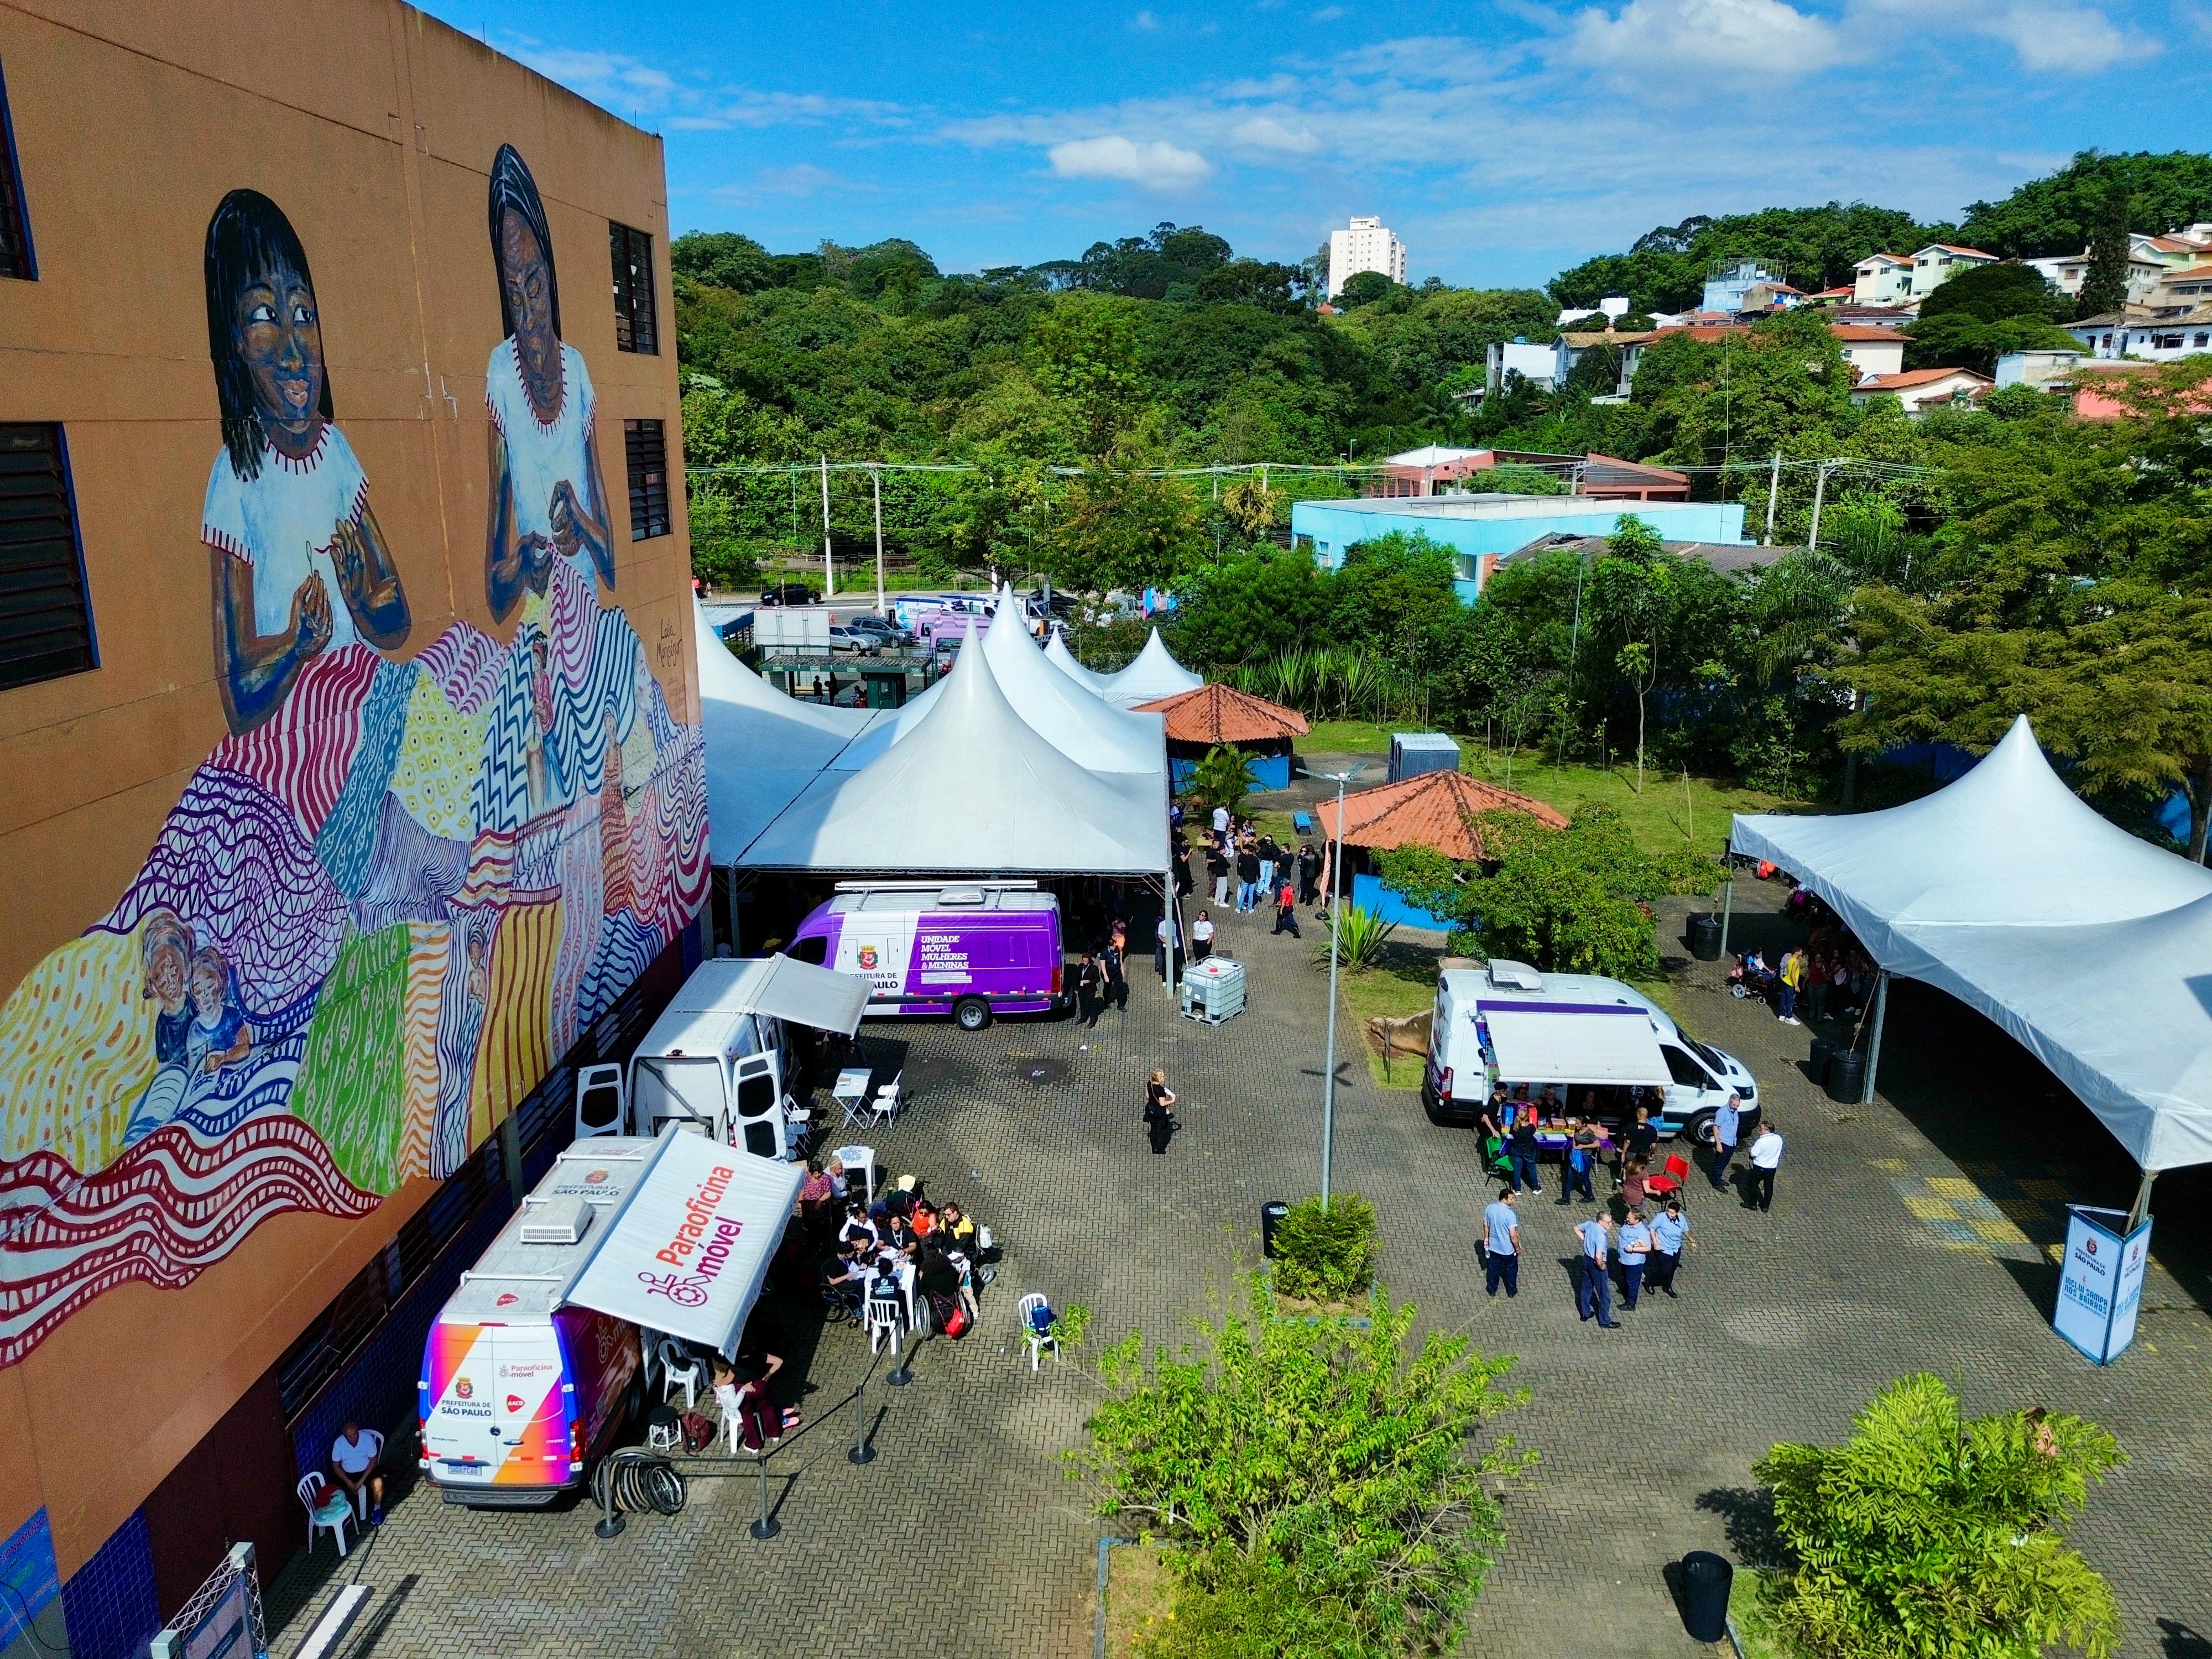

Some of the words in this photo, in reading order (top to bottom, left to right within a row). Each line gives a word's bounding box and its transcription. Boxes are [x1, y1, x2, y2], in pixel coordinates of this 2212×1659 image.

[921, 935, 960, 943] UNIDADE
[921, 942, 951, 952] MÓVEL
[655, 1166, 734, 1267] Paraoficina
[696, 1216, 744, 1277] móvel
[2075, 1252, 2086, 1263] SÃO
[2086, 1260, 2105, 1276] PAULO
[2079, 1292, 2107, 1314] BAIRROS
[2086, 1288, 2107, 1307] SAMPA
[441, 1406, 460, 1415] SÃO
